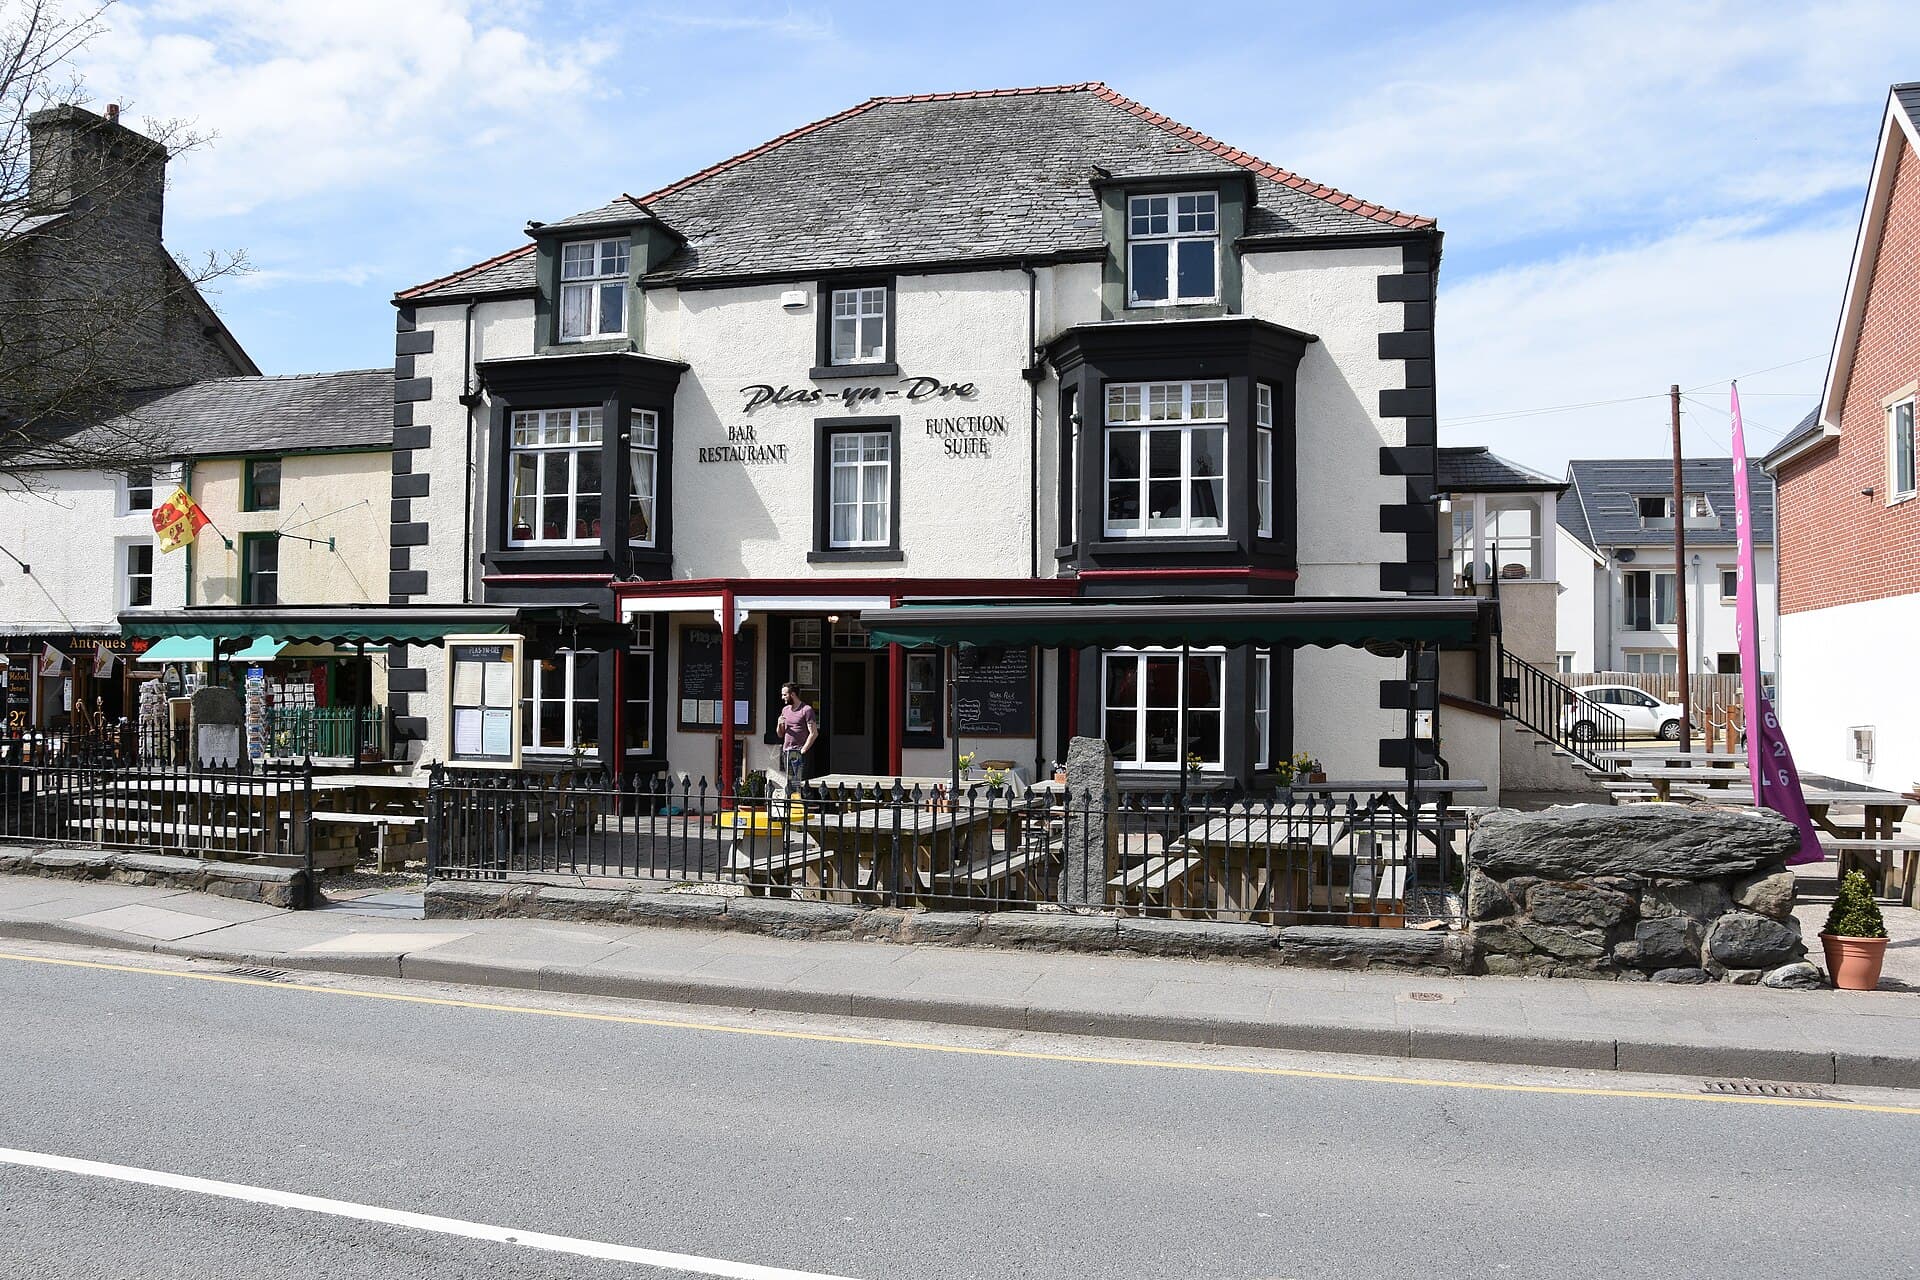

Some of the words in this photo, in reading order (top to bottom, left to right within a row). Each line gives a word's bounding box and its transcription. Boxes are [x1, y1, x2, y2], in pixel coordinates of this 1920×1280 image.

[728, 425, 755, 441] BAR
[926, 416, 1005, 435] FUNCTION
[699, 444, 786, 463] RESTAURANT
[944, 438, 988, 455] SUITE
[9, 710, 27, 727] 27
